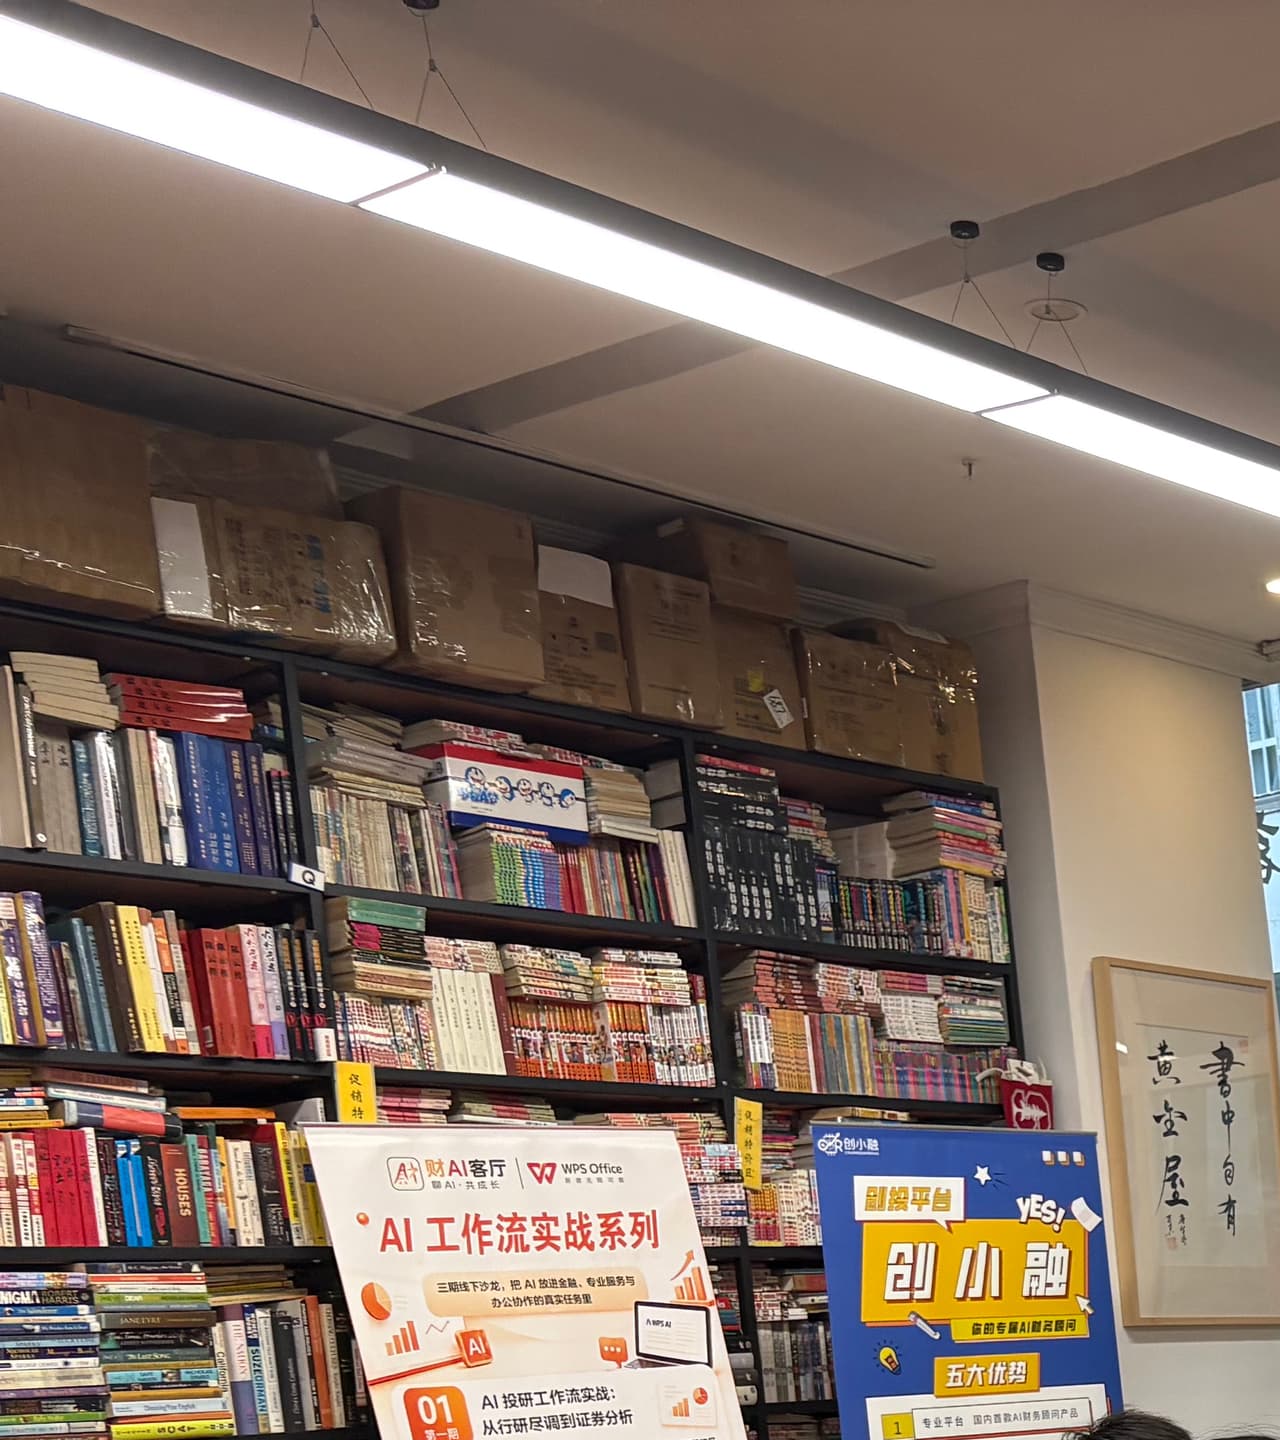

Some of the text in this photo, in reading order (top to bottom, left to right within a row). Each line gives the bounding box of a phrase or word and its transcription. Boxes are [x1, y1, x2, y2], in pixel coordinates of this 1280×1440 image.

[302, 871, 315, 885] Q
[843, 1138, 880, 1151] 创小融
[425, 1158, 507, 1178] 财AI客厅
[561, 1163, 623, 1174] WPS Office
[174, 1168, 192, 1217] HOUSES
[1016, 1194, 1065, 1232] YES!
[379, 1209, 660, 1255] AI 工作流实战系列
[884, 1241, 1072, 1302] 创小融
[524, 1279, 537, 1290] AI
[491, 1294, 592, 1308] 办公协作的真实任务里
[468, 1335, 486, 1356] AI
[945, 1361, 1028, 1388] 五大优势
[417, 1394, 453, 1424] 01
[481, 1395, 498, 1410] AI
[482, 1409, 634, 1436] 从行研尽调到证券分析
[893, 1421, 901, 1435] 1
[922, 1416, 964, 1429] 专业平台
